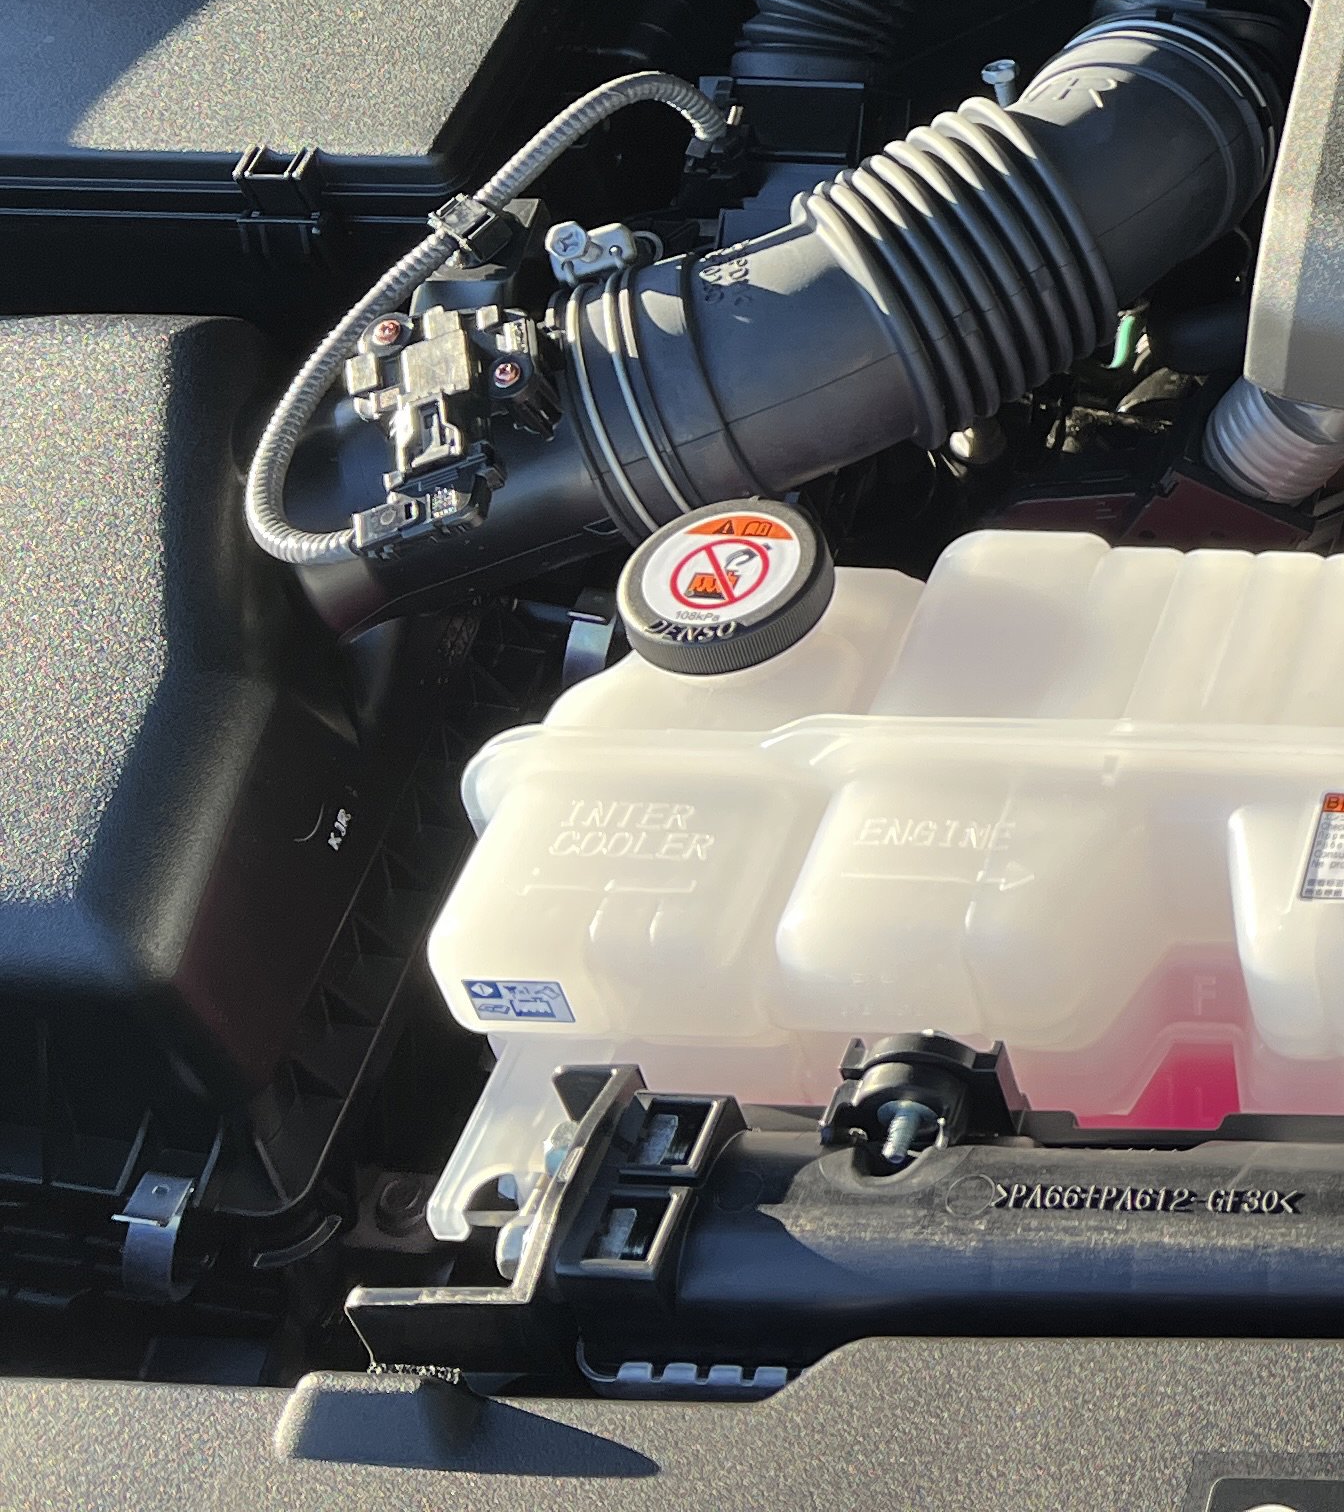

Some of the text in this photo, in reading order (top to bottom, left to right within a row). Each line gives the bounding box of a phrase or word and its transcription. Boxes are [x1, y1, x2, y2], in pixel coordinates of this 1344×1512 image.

[674, 610, 720, 622] 108kPa
[645, 619, 738, 641] DENSO
[560, 800, 695, 830] INTER
[1326, 796, 1340, 809] B
[548, 831, 715, 861] COOLER
[853, 817, 1016, 850] ENGINE
